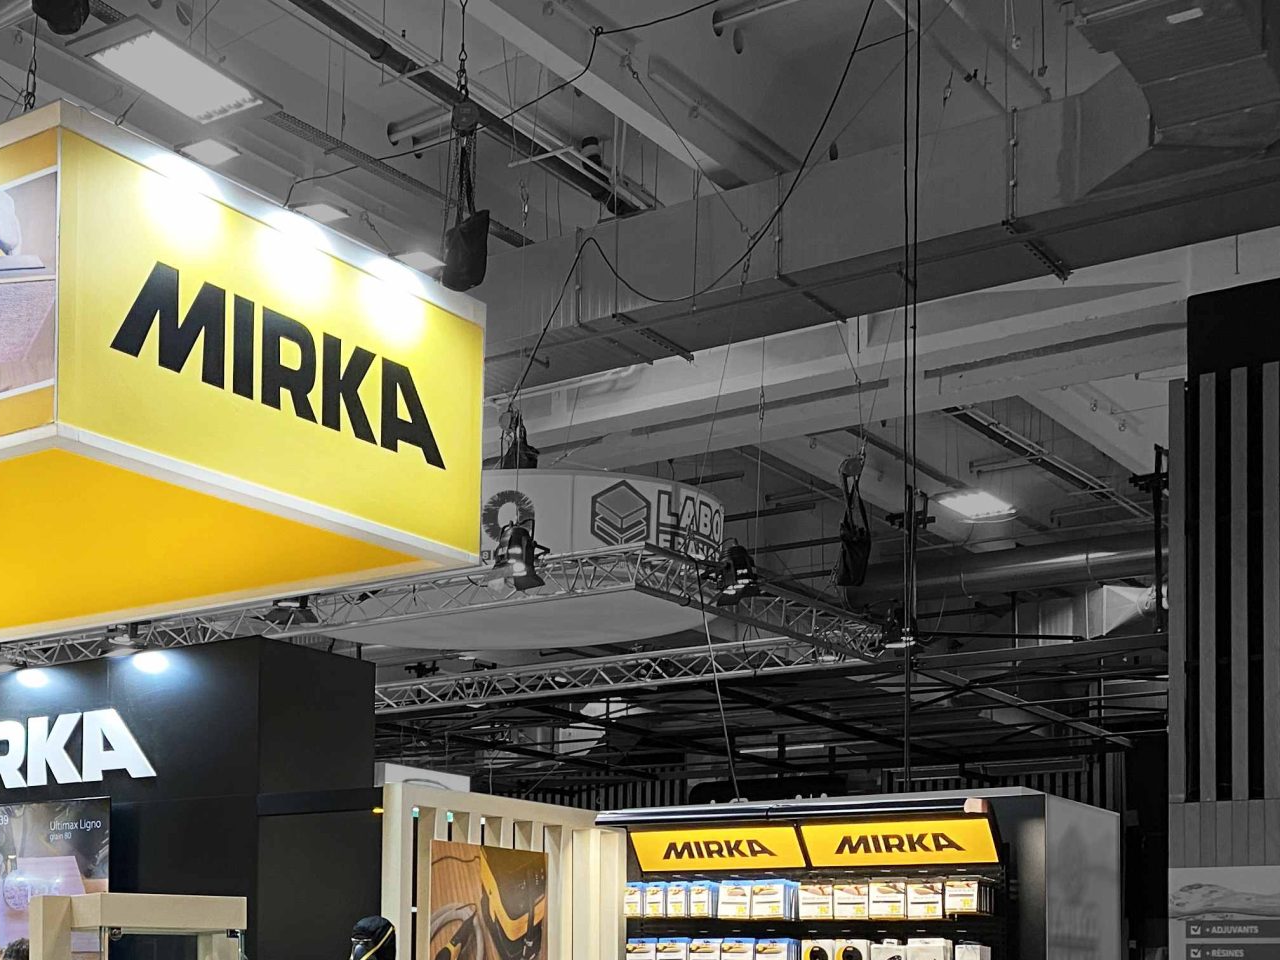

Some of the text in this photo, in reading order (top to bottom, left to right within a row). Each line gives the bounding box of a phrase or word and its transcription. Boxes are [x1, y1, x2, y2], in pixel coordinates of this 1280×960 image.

[110, 261, 446, 470] MIRKA
[657, 490, 723, 545] LABO
[50, 819, 102, 832] Ultimax Ligno
[662, 839, 778, 860] MIRKA
[834, 832, 966, 855] MIRKA
[1211, 925, 1260, 934] ADJUVANTS
